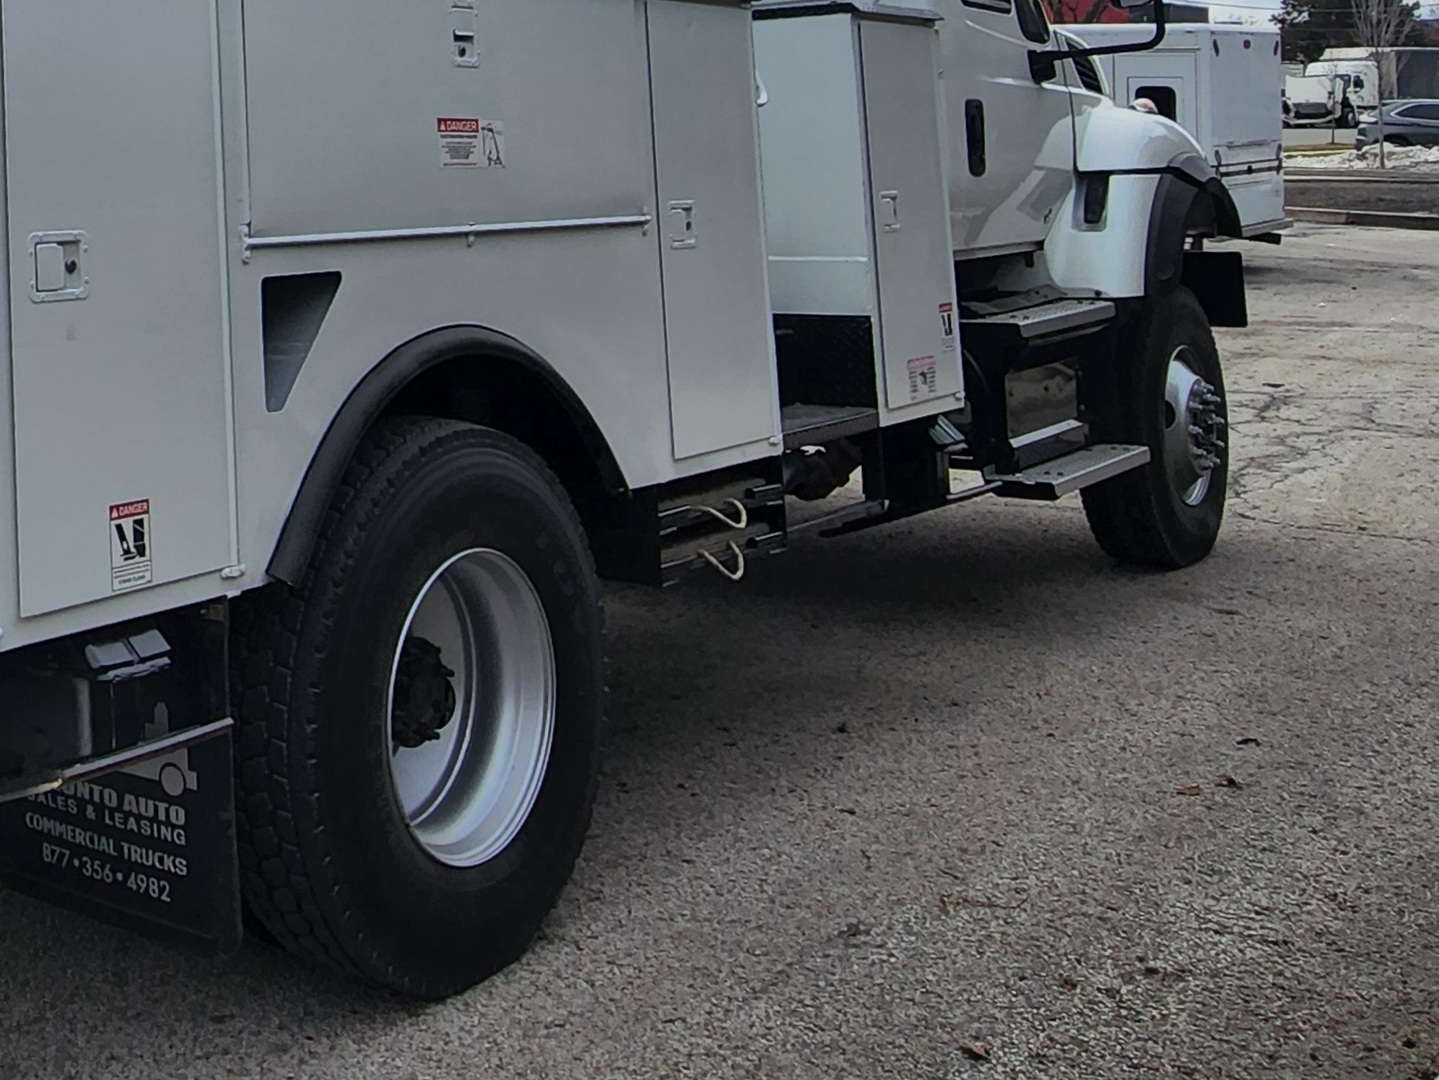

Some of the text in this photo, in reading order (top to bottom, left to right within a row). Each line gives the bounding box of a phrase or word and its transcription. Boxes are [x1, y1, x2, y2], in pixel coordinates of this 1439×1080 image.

[446, 120, 477, 130] DANGER
[119, 502, 148, 517] DANGER
[85, 804, 96, 820] &
[104, 808, 187, 846] LEASING
[123, 793, 187, 826] AUTO
[25, 811, 188, 876] COMMERCIAL TRUCKS
